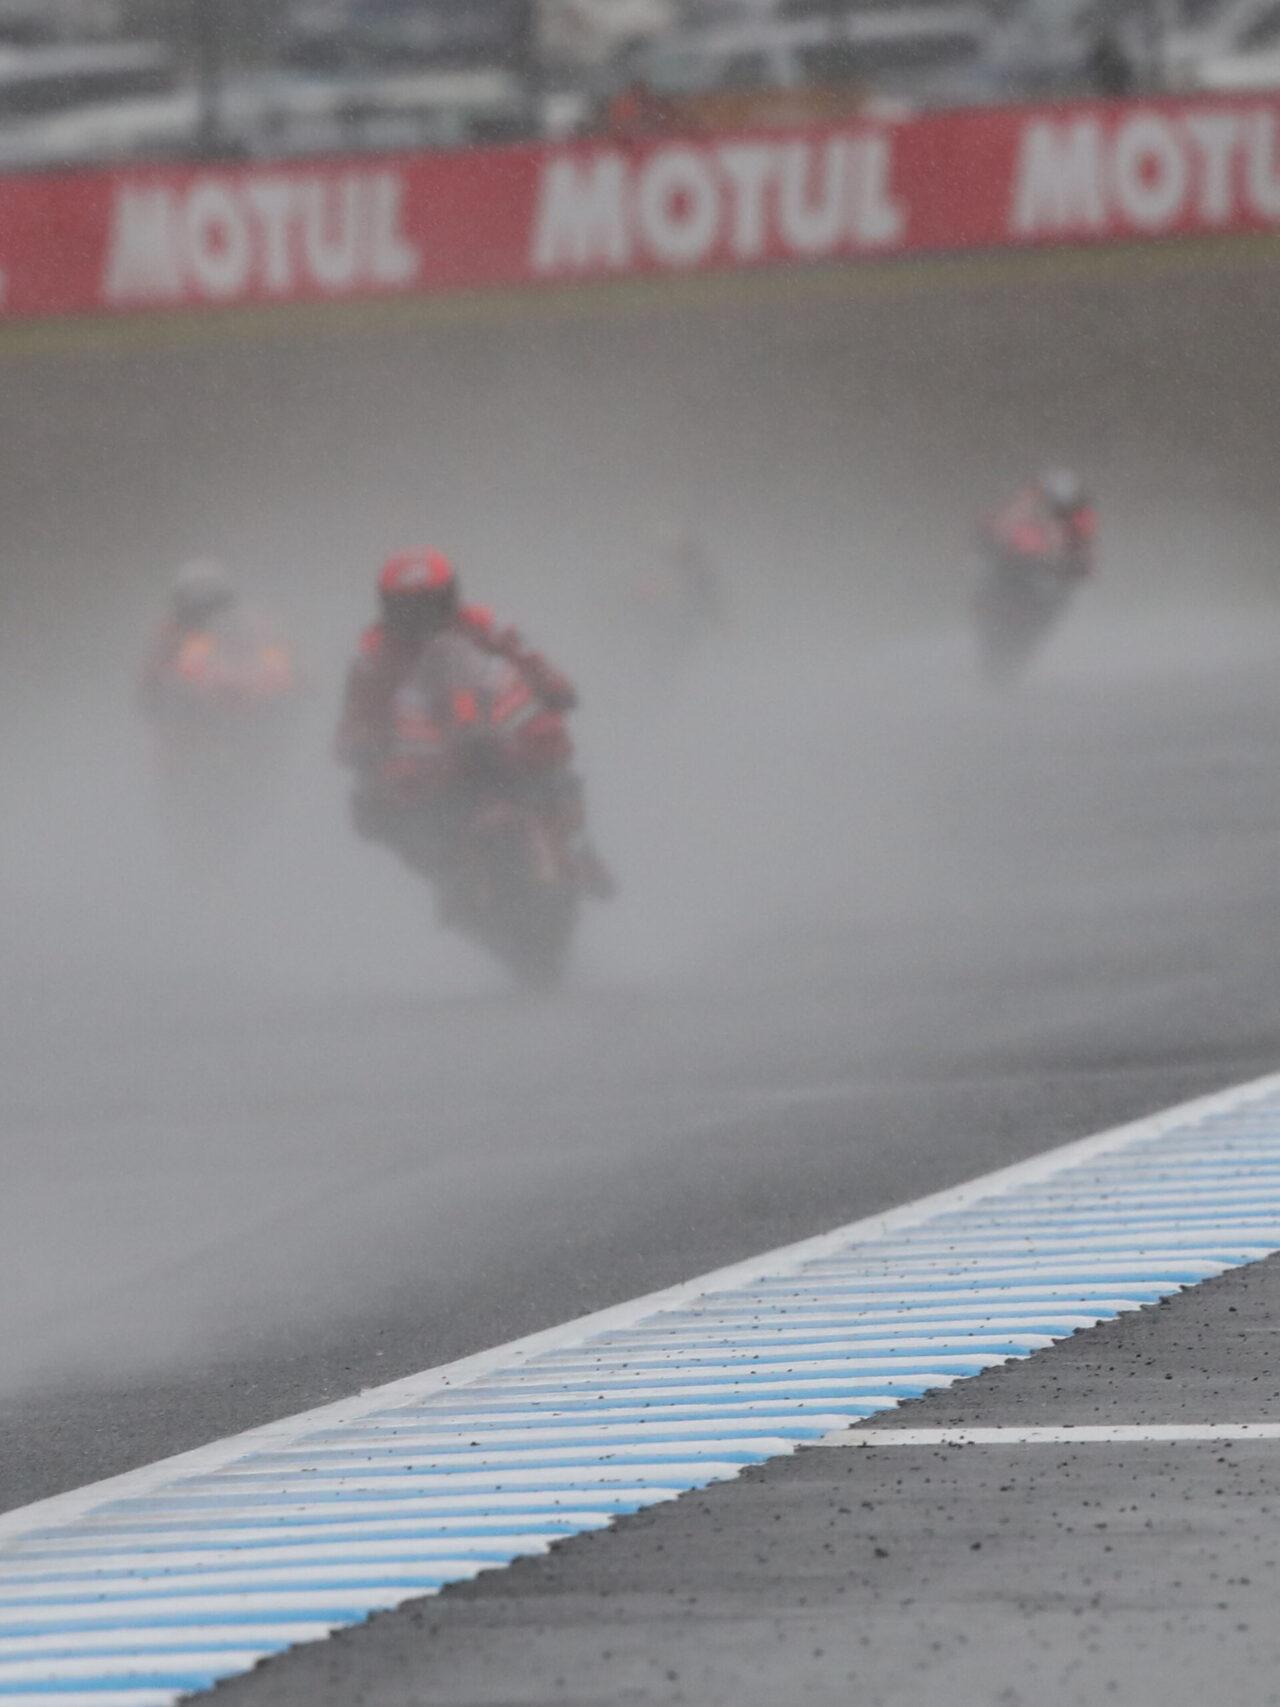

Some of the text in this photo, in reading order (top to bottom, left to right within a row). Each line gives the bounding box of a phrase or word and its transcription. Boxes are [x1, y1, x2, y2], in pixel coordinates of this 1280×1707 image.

[532, 135, 904, 271] MOTUL
[1014, 107, 1280, 233] MOTU
[106, 172, 419, 301] MOTUL
